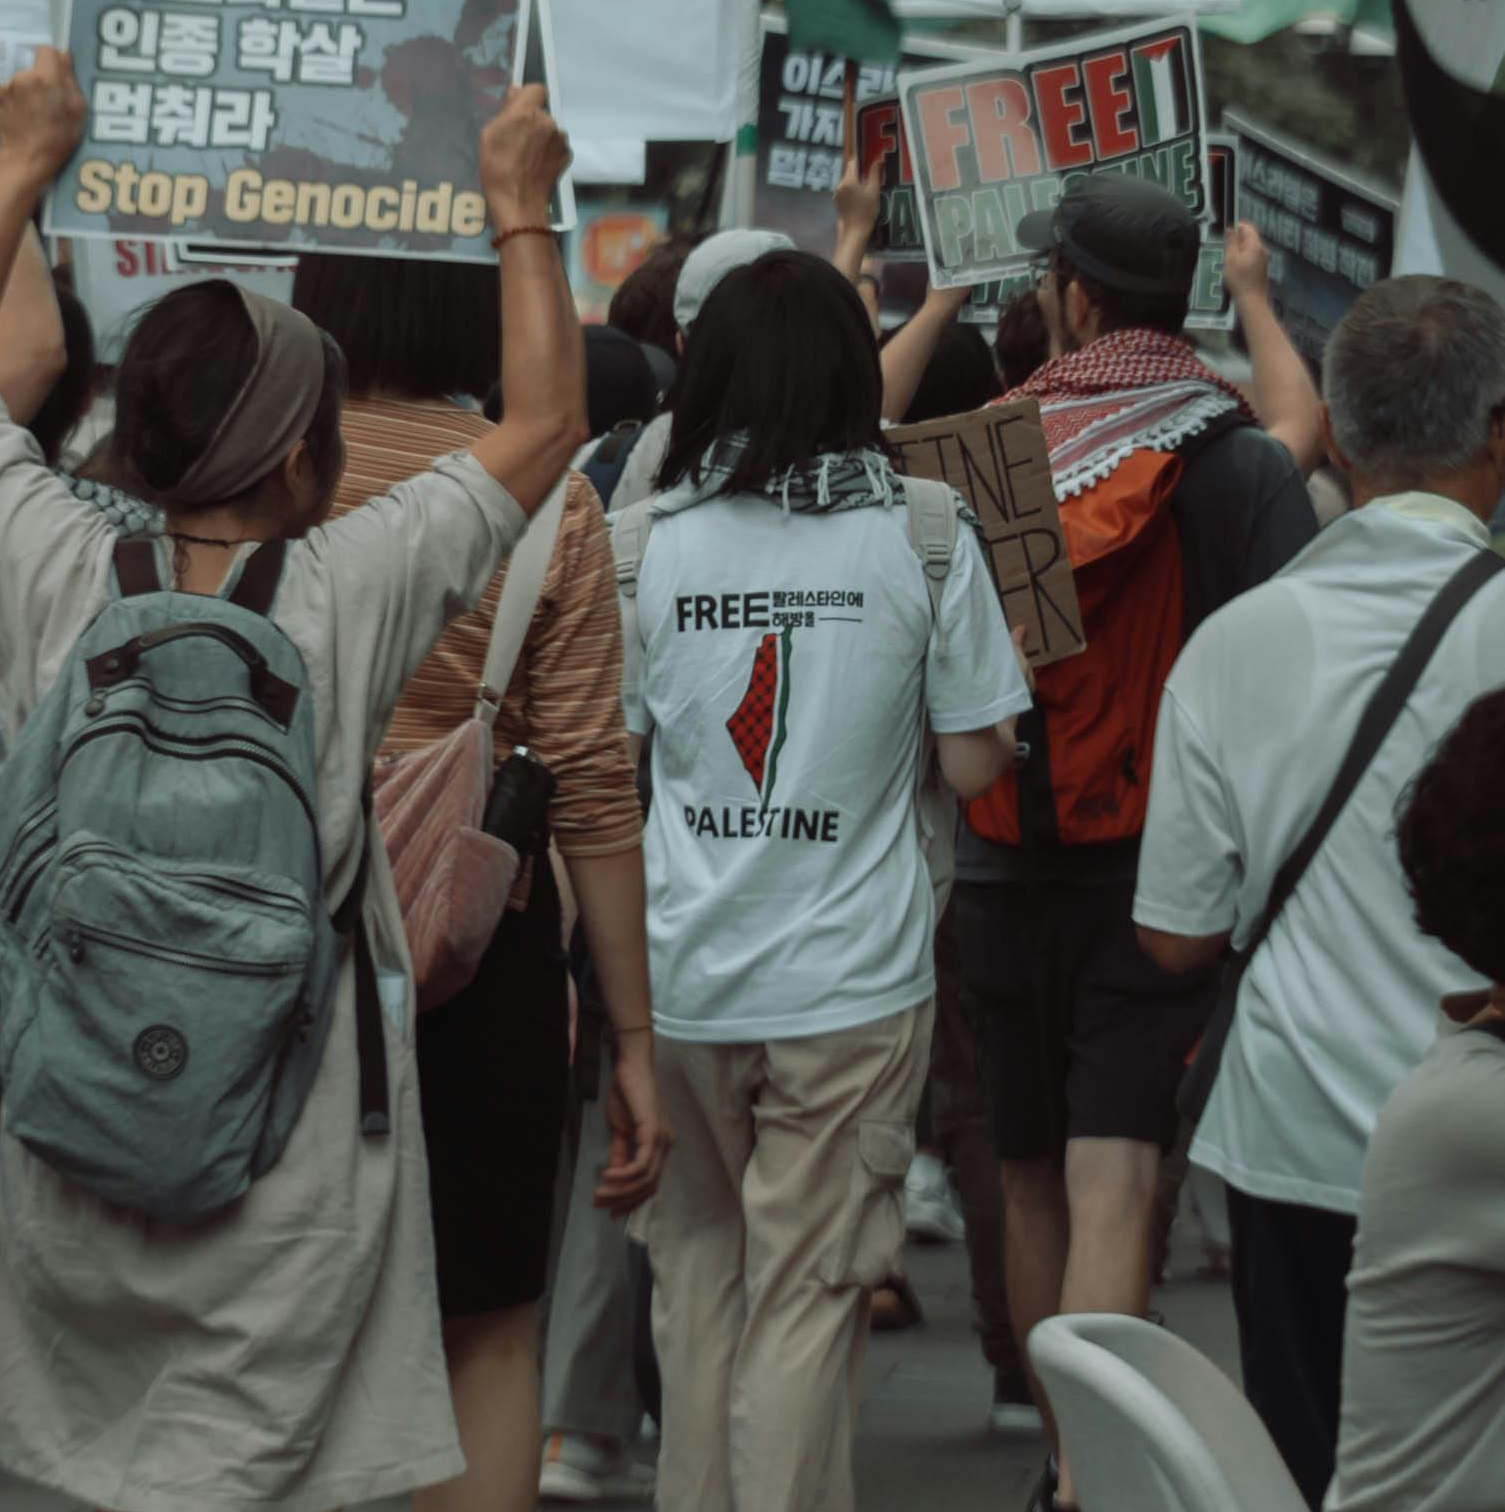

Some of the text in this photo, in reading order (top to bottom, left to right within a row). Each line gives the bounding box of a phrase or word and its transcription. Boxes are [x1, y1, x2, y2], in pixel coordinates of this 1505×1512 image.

[97, 8, 363, 86] 인종 학살
[90, 80, 277, 151] 멈춰라
[914, 51, 1140, 193] FREE
[76, 159, 488, 237] Stop Genocide
[676, 592, 770, 632] FREE
[771, 611, 815, 628] 해방을
[684, 804, 839, 842] PALESTINE
